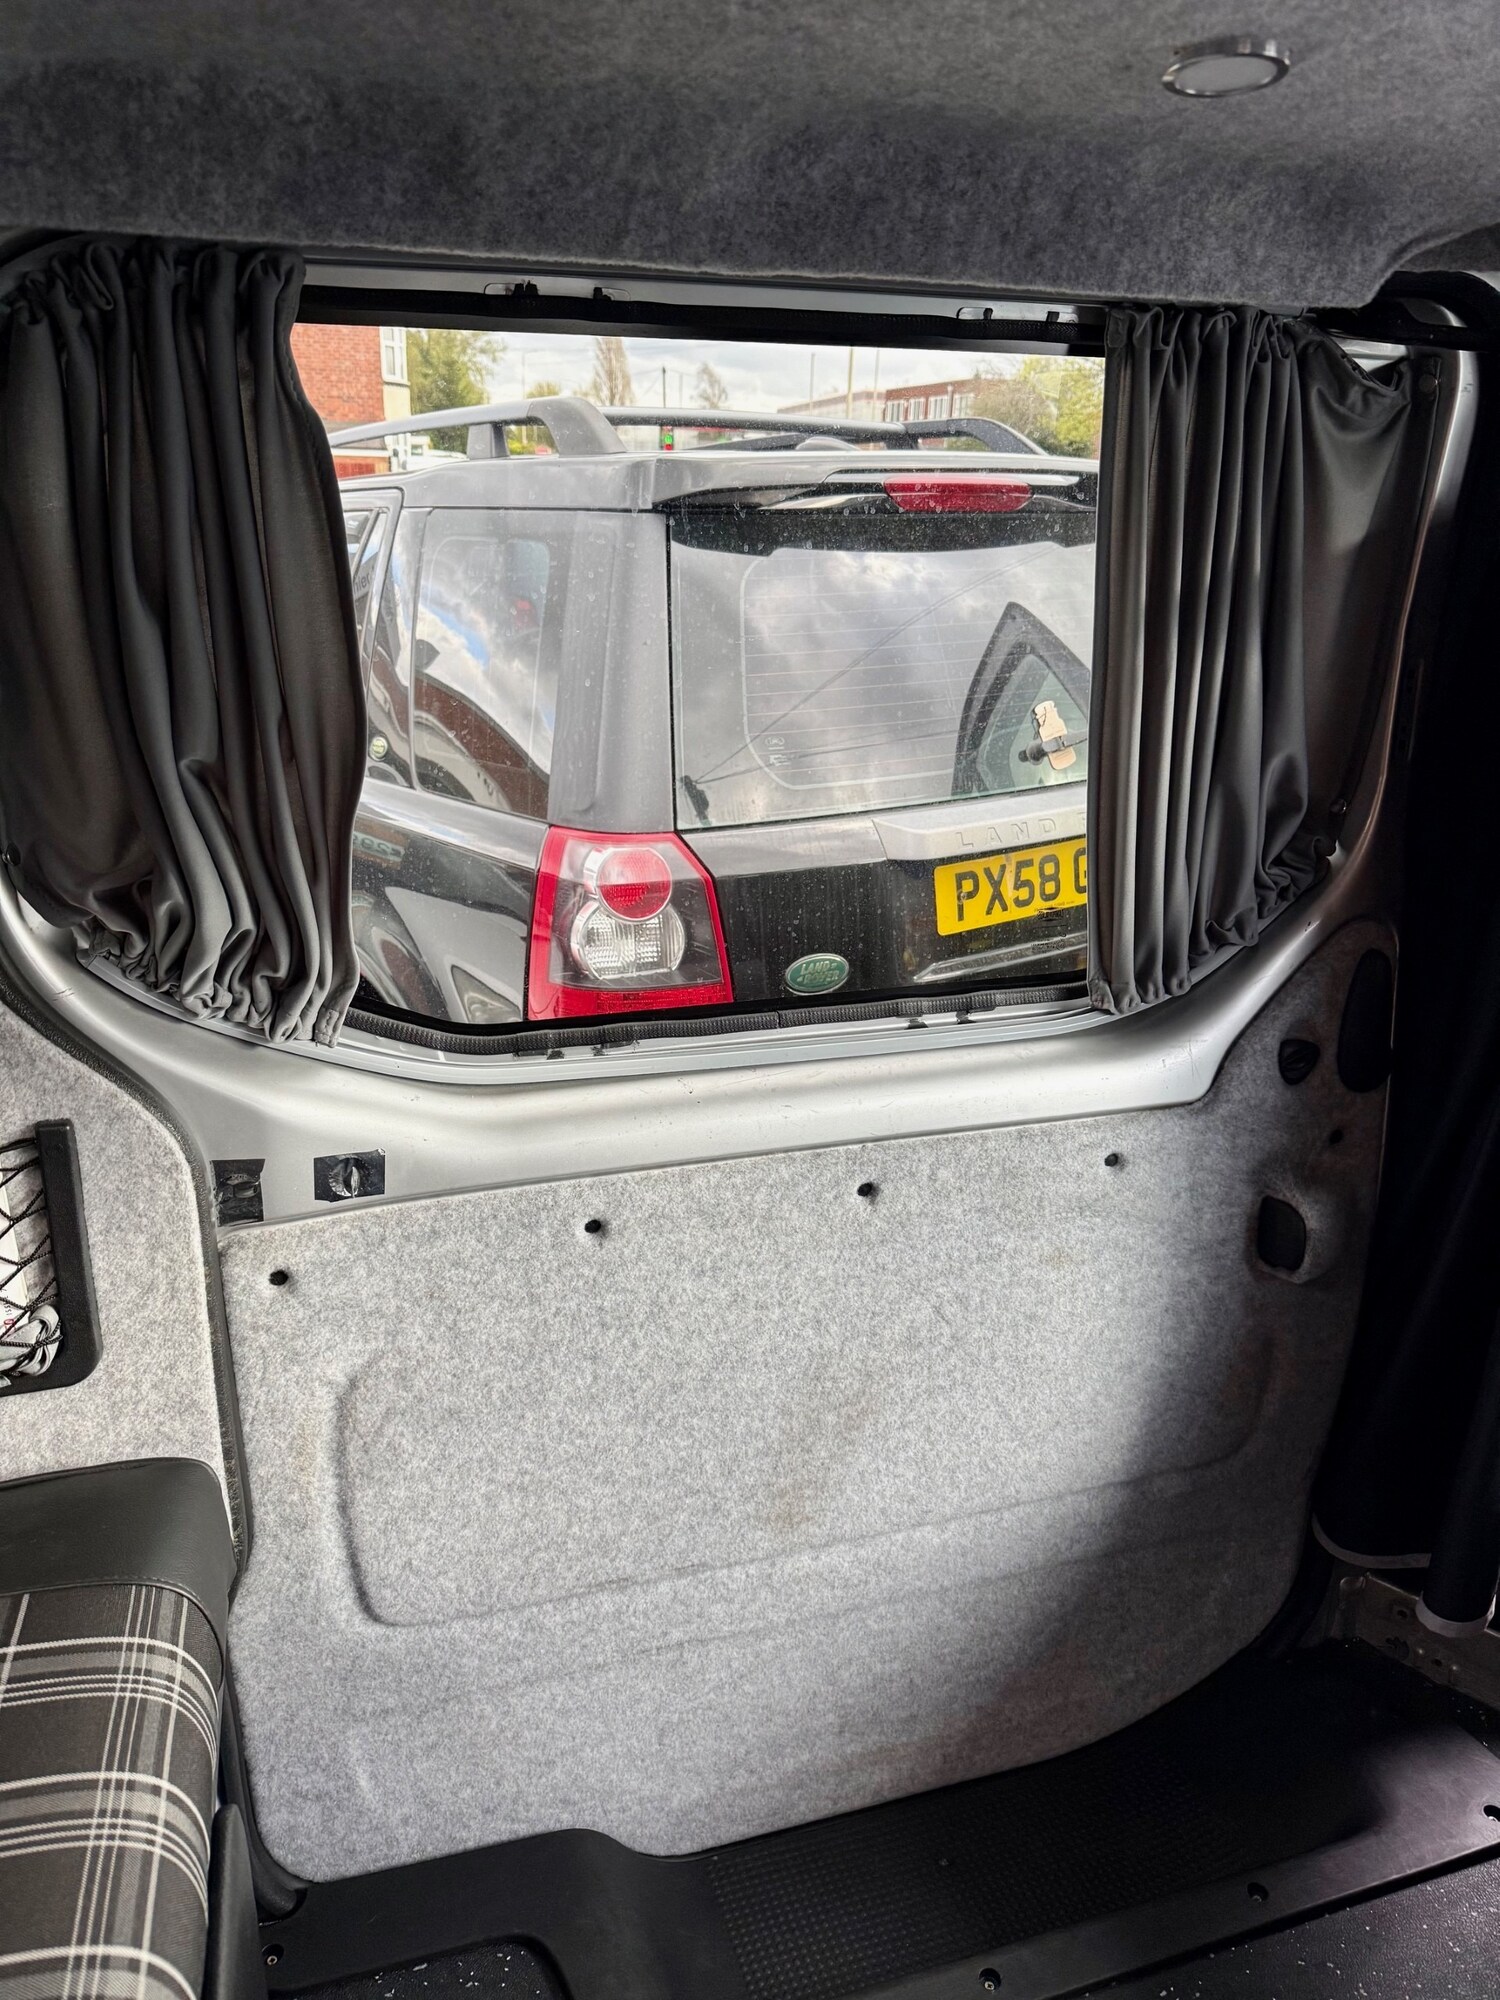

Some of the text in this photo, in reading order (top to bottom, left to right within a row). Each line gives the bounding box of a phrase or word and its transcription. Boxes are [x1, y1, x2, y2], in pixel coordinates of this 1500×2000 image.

[955, 818, 1056, 848] LAND
[954, 853, 1061, 922] PX58
[801, 961, 830, 975] LAND
